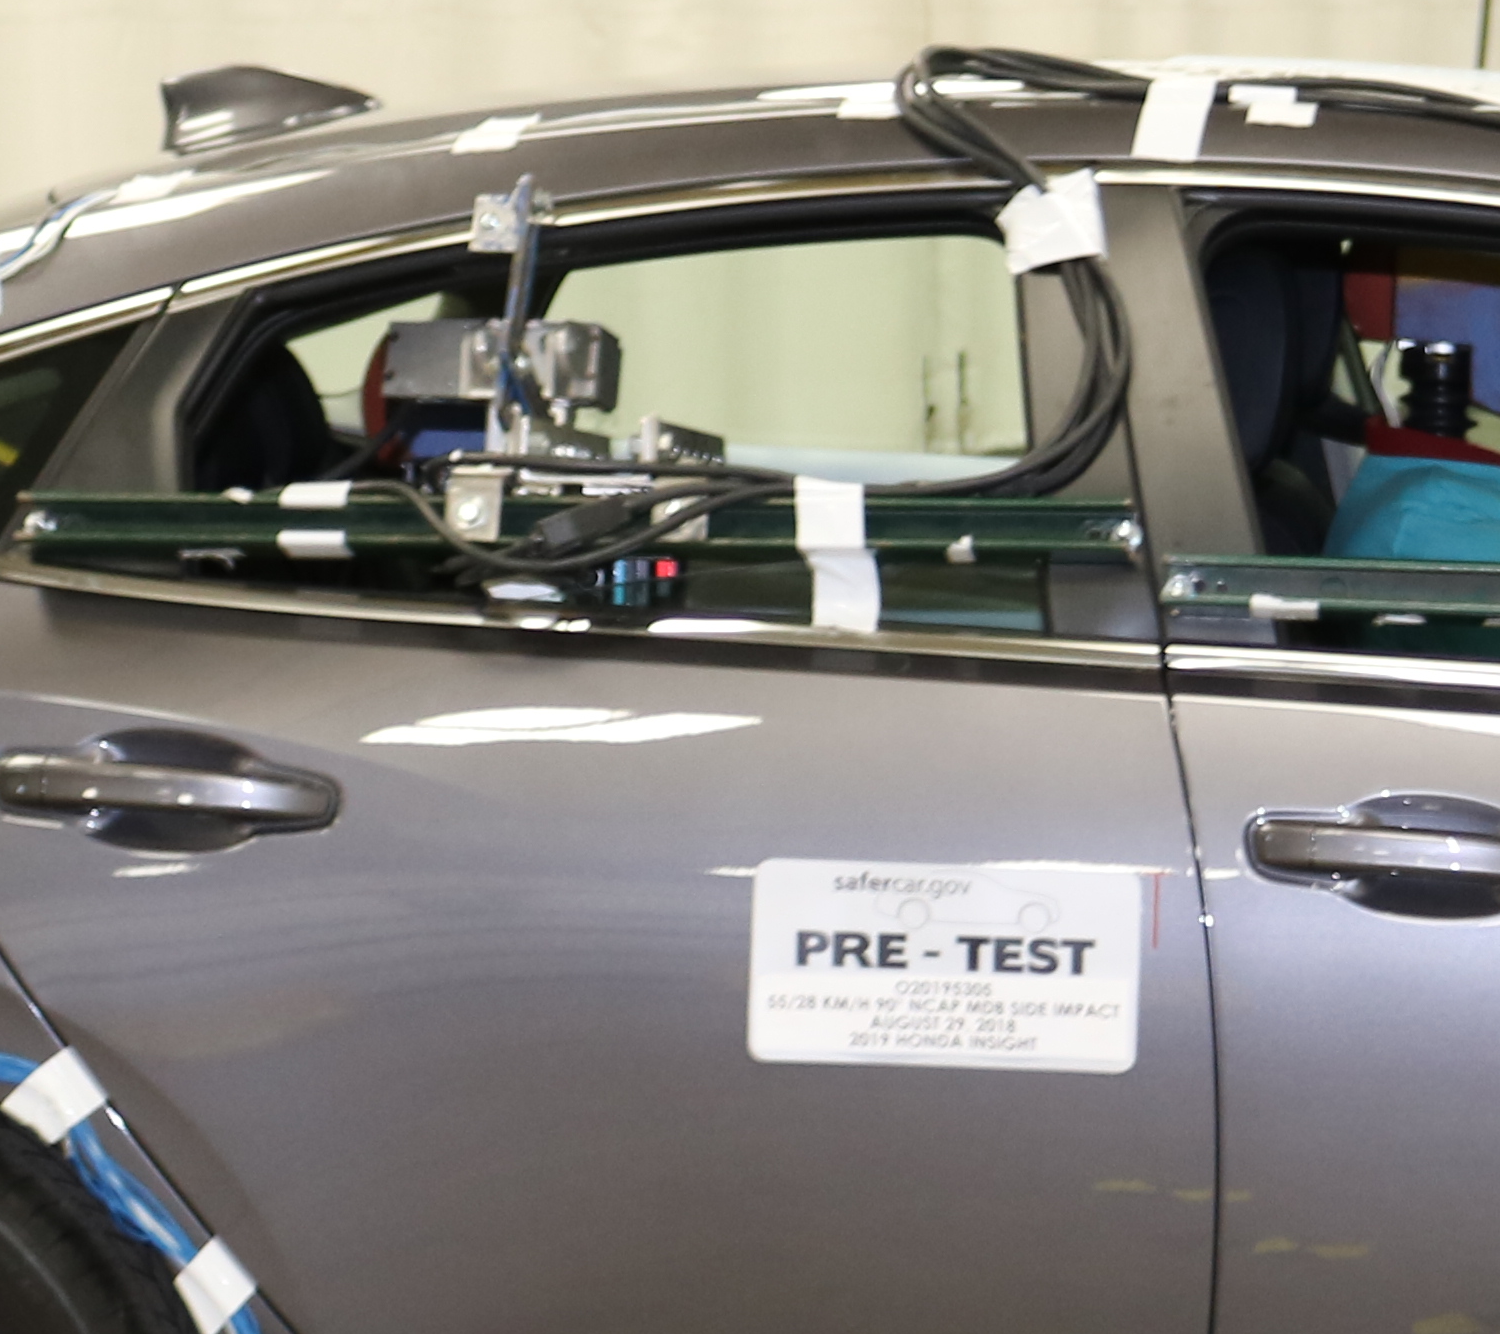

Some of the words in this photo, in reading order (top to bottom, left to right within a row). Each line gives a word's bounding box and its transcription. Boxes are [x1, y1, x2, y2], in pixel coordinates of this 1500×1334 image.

[834, 871, 971, 898] safercar.gov
[795, 929, 908, 969] PRE
[957, 935, 1097, 976] TEST
[909, 998, 961, 1014] NCAP
[1010, 1000, 1048, 1017] SIDE
[1053, 1002, 1121, 1019] IMPACT
[869, 1014, 940, 1031] AUGUST
[975, 1017, 1016, 1034] 2018
[849, 1032, 890, 1048] 2019
[896, 1033, 963, 1049] HONDA
[969, 1035, 1038, 1052] INSIGHT
